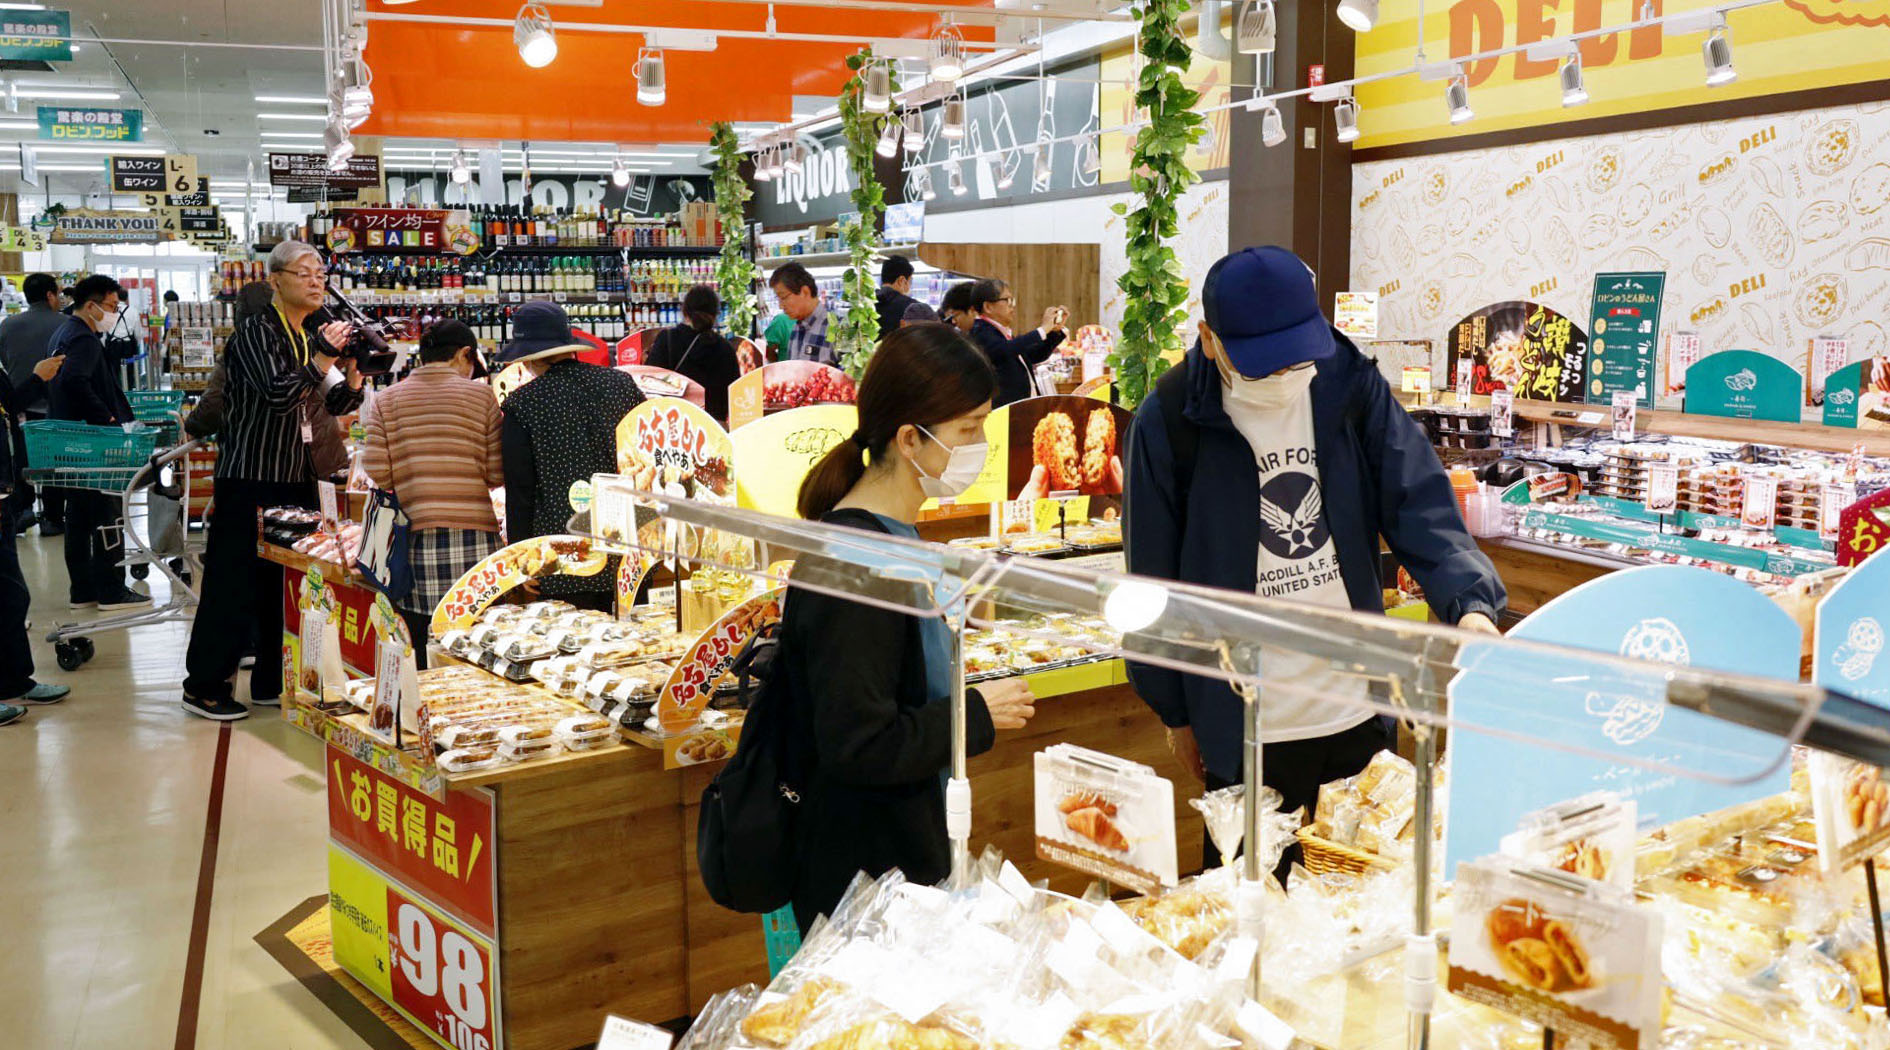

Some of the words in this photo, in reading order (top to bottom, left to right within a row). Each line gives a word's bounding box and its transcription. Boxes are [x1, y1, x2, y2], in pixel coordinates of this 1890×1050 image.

[1448, 0, 1663, 88] DELI
[52, 125, 129, 139] ロビンフッド
[1739, 126, 1777, 154] DELI
[1536, 150, 1564, 174] DELI
[175, 175, 190, 191] 6
[777, 146, 850, 214] LIQUOR
[1382, 168, 1405, 188] DELI
[59, 218, 117, 229] THANK
[120, 218, 159, 230] YOU!
[164, 219, 175, 230] 4
[365, 214, 440, 230] ワイン均一
[17, 238, 26, 248] 4
[35, 241, 43, 251] 3
[370, 232, 435, 246] SALE
[1379, 279, 1401, 297] DELI
[1530, 276, 1558, 298] DELI
[1729, 273, 1766, 298] DELI
[638, 408, 706, 463] 名古屋めし
[654, 448, 689, 471] 食べやあ
[1257, 564, 1304, 584] ACDILL
[1308, 558, 1329, 573] A.F.
[1262, 577, 1309, 598] UNITED
[1312, 568, 1342, 587] STAT
[445, 562, 509, 621] 名古屋めし
[469, 585, 500, 615] 食べやあ
[671, 624, 745, 706] 名古屋めし
[699, 655, 733, 696] 食べやあ
[350, 768, 459, 879] お買得品
[398, 903, 487, 1030] 98
